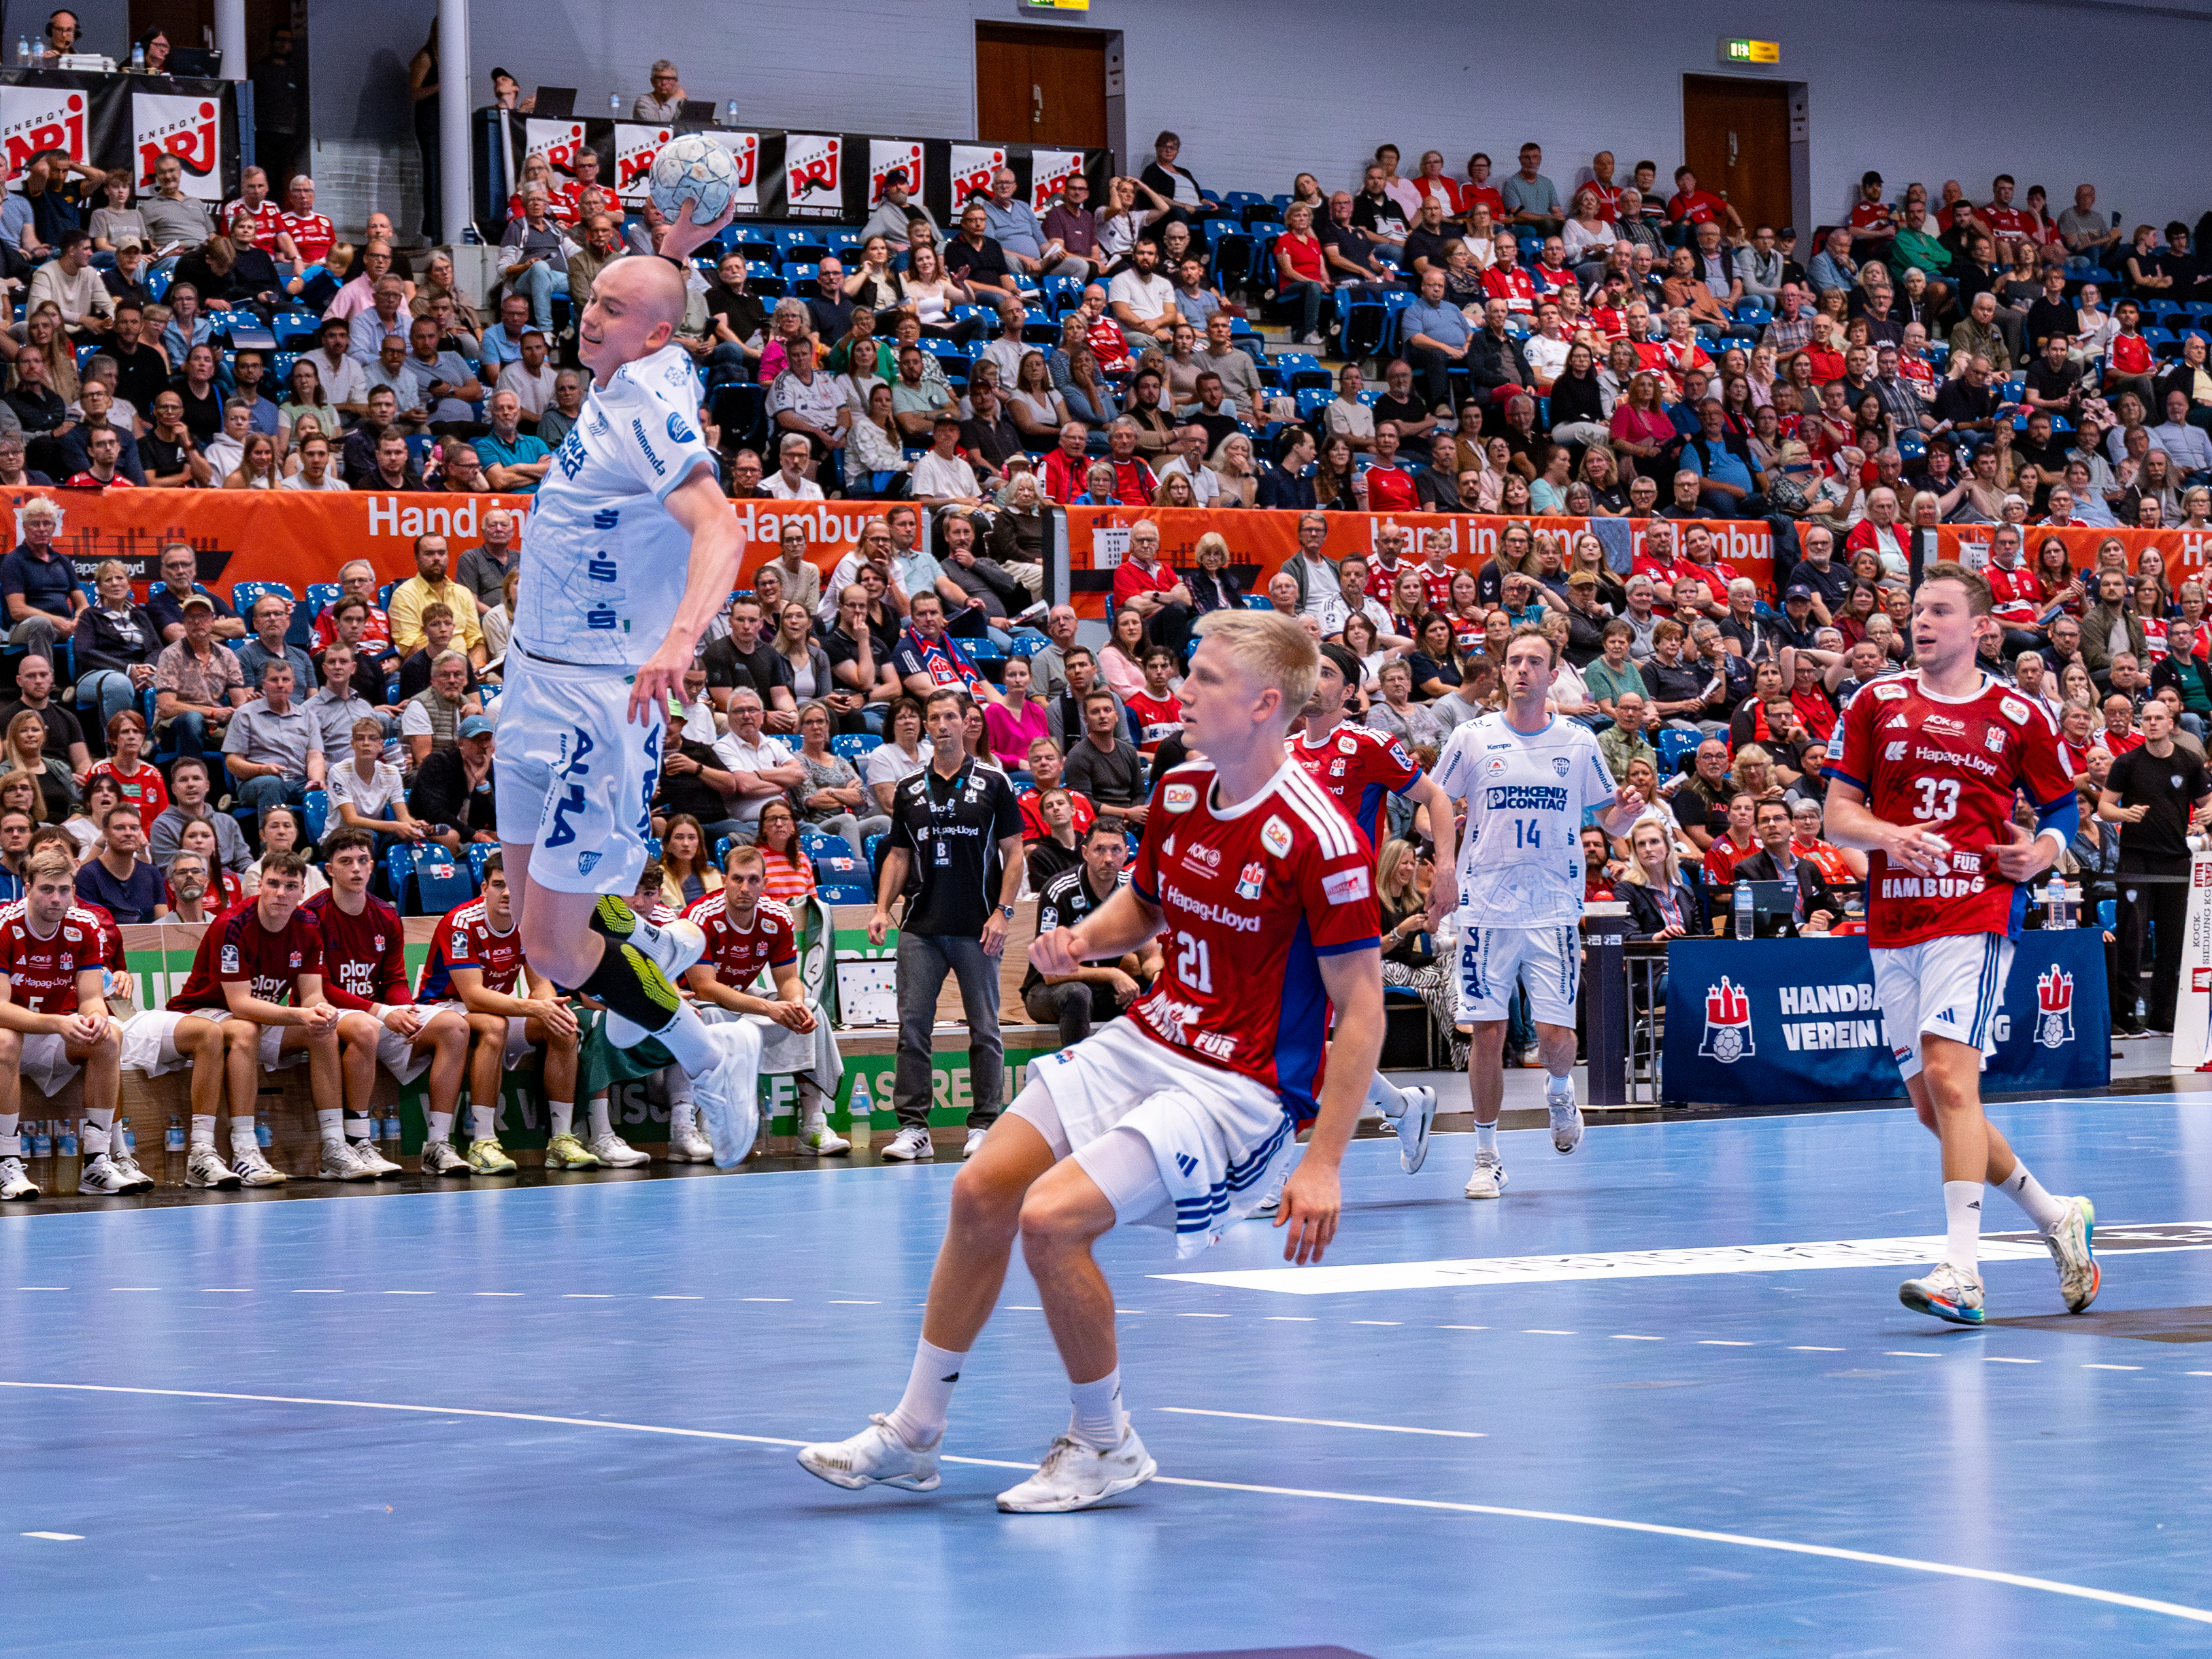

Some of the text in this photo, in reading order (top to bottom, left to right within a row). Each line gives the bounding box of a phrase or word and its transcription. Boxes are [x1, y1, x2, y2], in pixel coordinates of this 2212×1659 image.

[5, 108, 65, 135] ENERGY
[139, 116, 197, 142] ENERGY
[529, 135, 569, 153] ENERGY
[618, 139, 657, 158] ENERGY
[788, 150, 826, 168] ENERGY
[790, 140, 838, 199] NRJ
[873, 154, 910, 173] ENERGY
[953, 161, 992, 178] ENERGY
[1035, 165, 1071, 183] ENERGY
[789, 207, 801, 215] HIT
[802, 207, 820, 216] MUSIC
[822, 208, 838, 217] ONLY
[632, 418, 666, 477] animonda
[368, 497, 477, 537] Hand
[1469, 519, 1497, 554] in
[1880, 687, 1902, 695] Dole
[1925, 714, 1951, 726] AOK
[2004, 701, 2026, 716] Dole
[1341, 739, 1356, 750] Dole
[1442, 750, 1462, 786] animonda
[1915, 747, 1998, 776] Hapag-Lloyd
[1591, 755, 1613, 794] animonda
[1167, 790, 1192, 801] Dole
[1912, 777, 1961, 820] 33
[1267, 822, 1288, 846] Dole
[1515, 818, 1541, 849] 14
[937, 842, 946, 858] B
[1187, 842, 1207, 858] AOK
[1882, 876, 1985, 899] HAMBURG
[1167, 885, 1261, 933] Hapag-Lloyd
[2202, 889, 2211, 965] SIEDLUNG KG
[30, 955, 46, 963] AOK
[340, 959, 376, 983] play
[1177, 931, 1213, 994] 21
[1462, 926, 1484, 1000] ALPLA
[24, 975, 72, 988] Hapag-Lloyd
[347, 979, 373, 995] itas
[1193, 1032, 1237, 1058] FÜR
[1783, 1020, 1877, 1051] VEREIN
